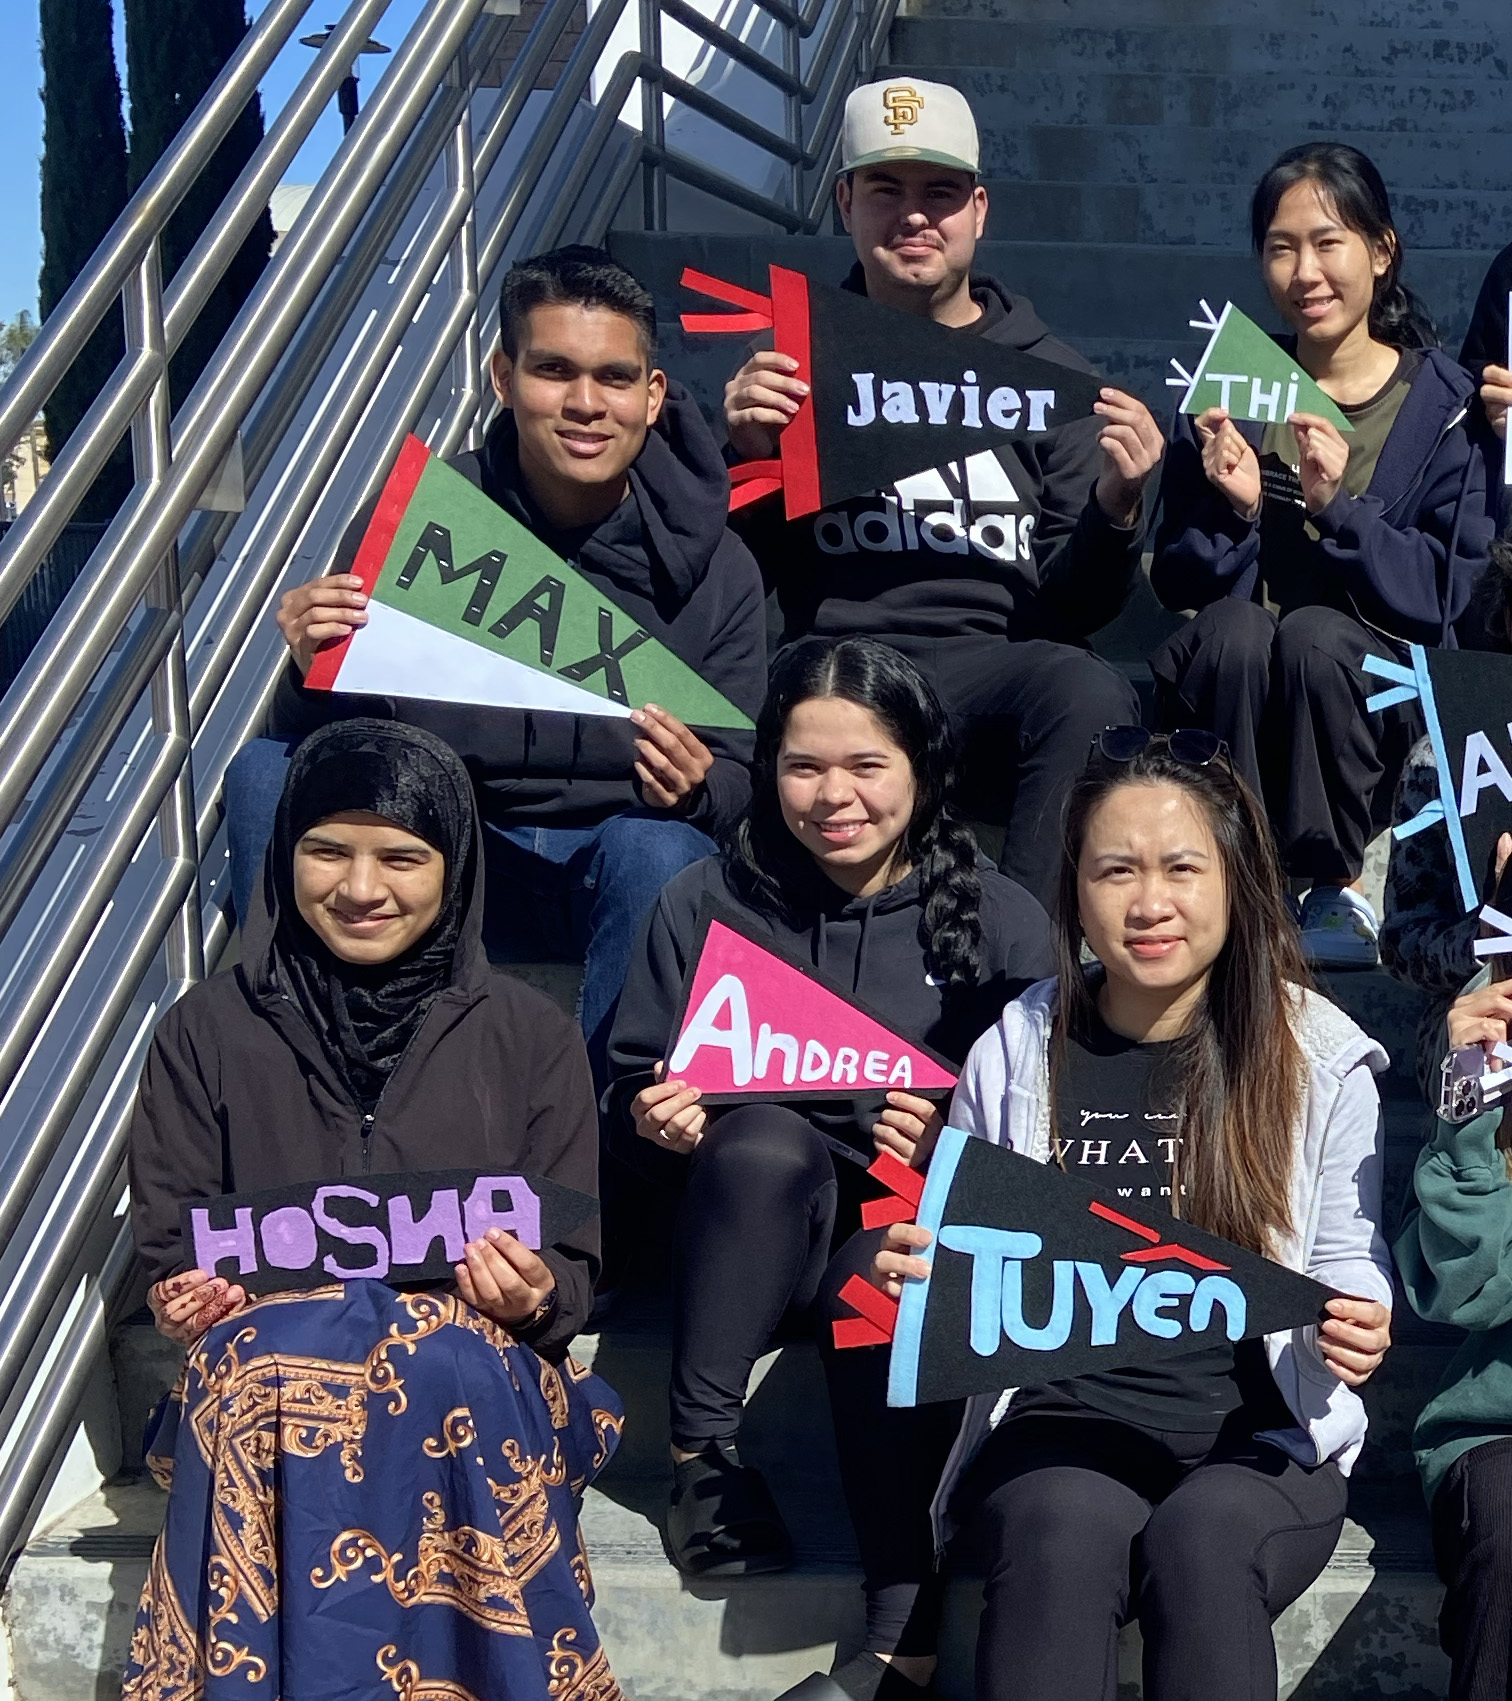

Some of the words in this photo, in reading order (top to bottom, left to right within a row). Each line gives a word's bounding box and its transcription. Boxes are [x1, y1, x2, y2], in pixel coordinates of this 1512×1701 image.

[846, 369, 1056, 432] Javier
[813, 491, 1036, 561] adidas
[395, 521, 652, 707] MAX
[1117, 1184, 1187, 1198] want
